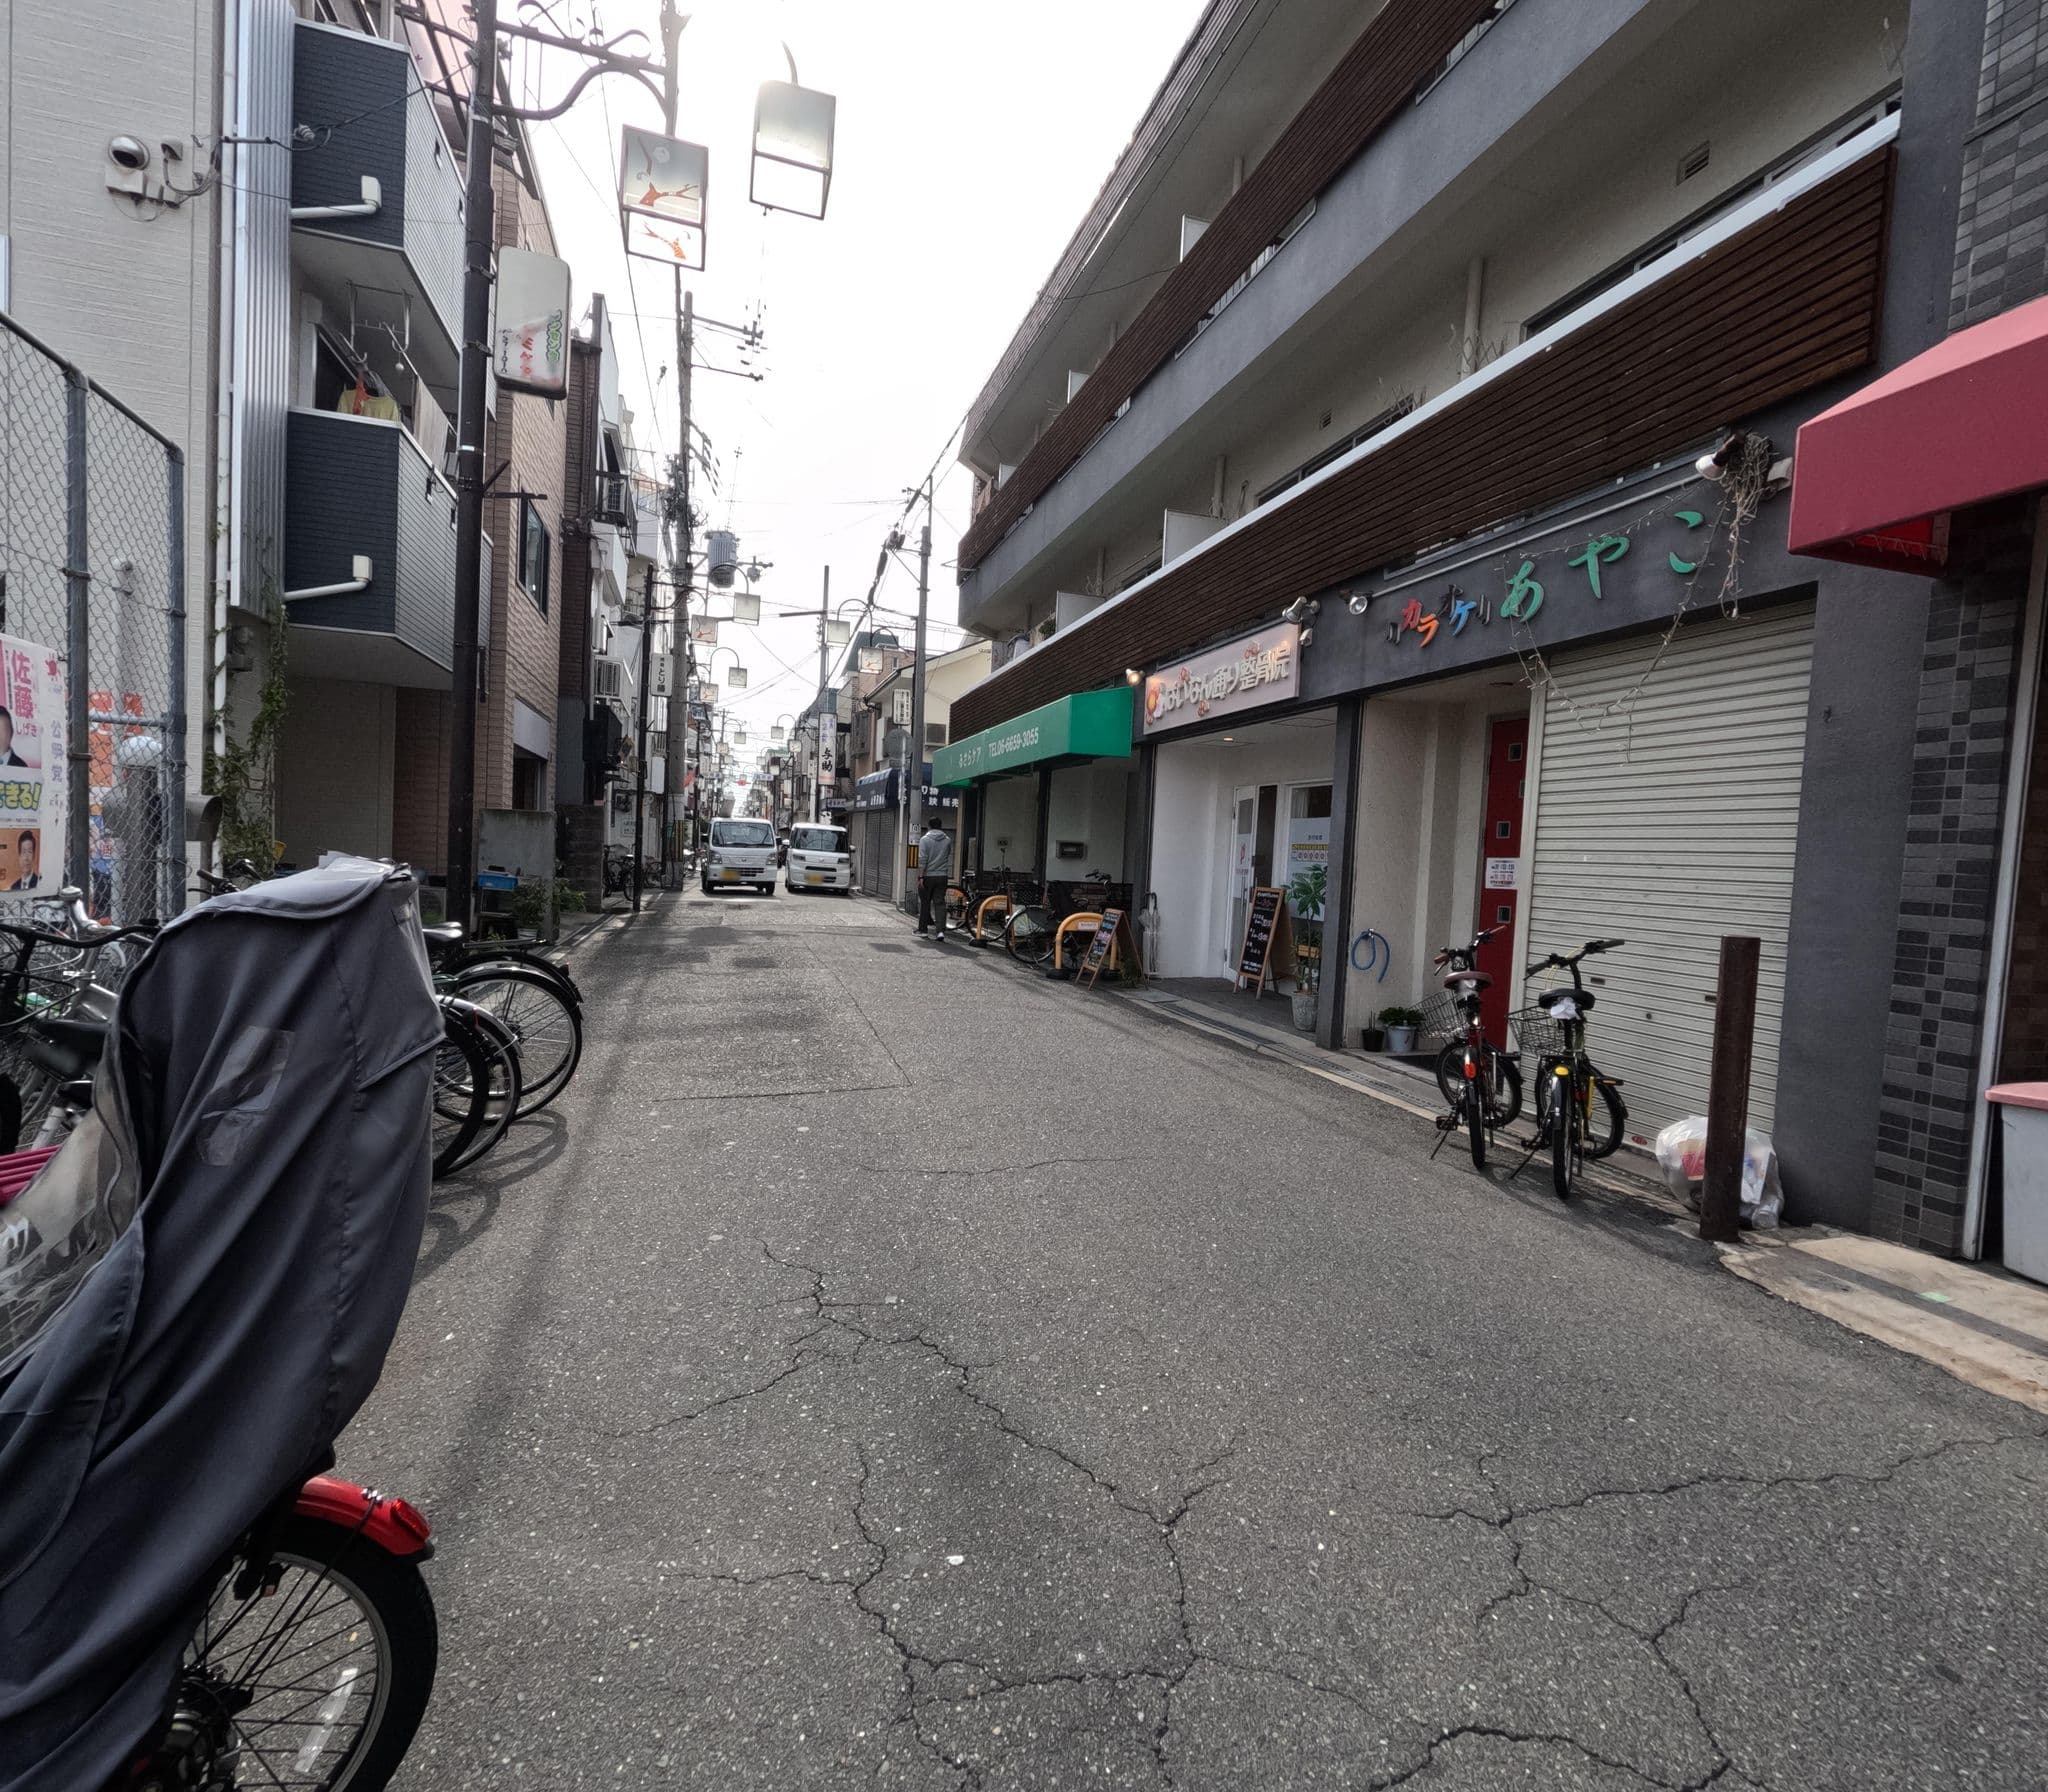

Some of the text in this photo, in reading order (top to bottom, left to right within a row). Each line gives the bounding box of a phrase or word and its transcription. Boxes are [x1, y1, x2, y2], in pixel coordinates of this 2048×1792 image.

[1500, 510, 1704, 623] あやこ
[12, 649, 34, 719] 佐藤
